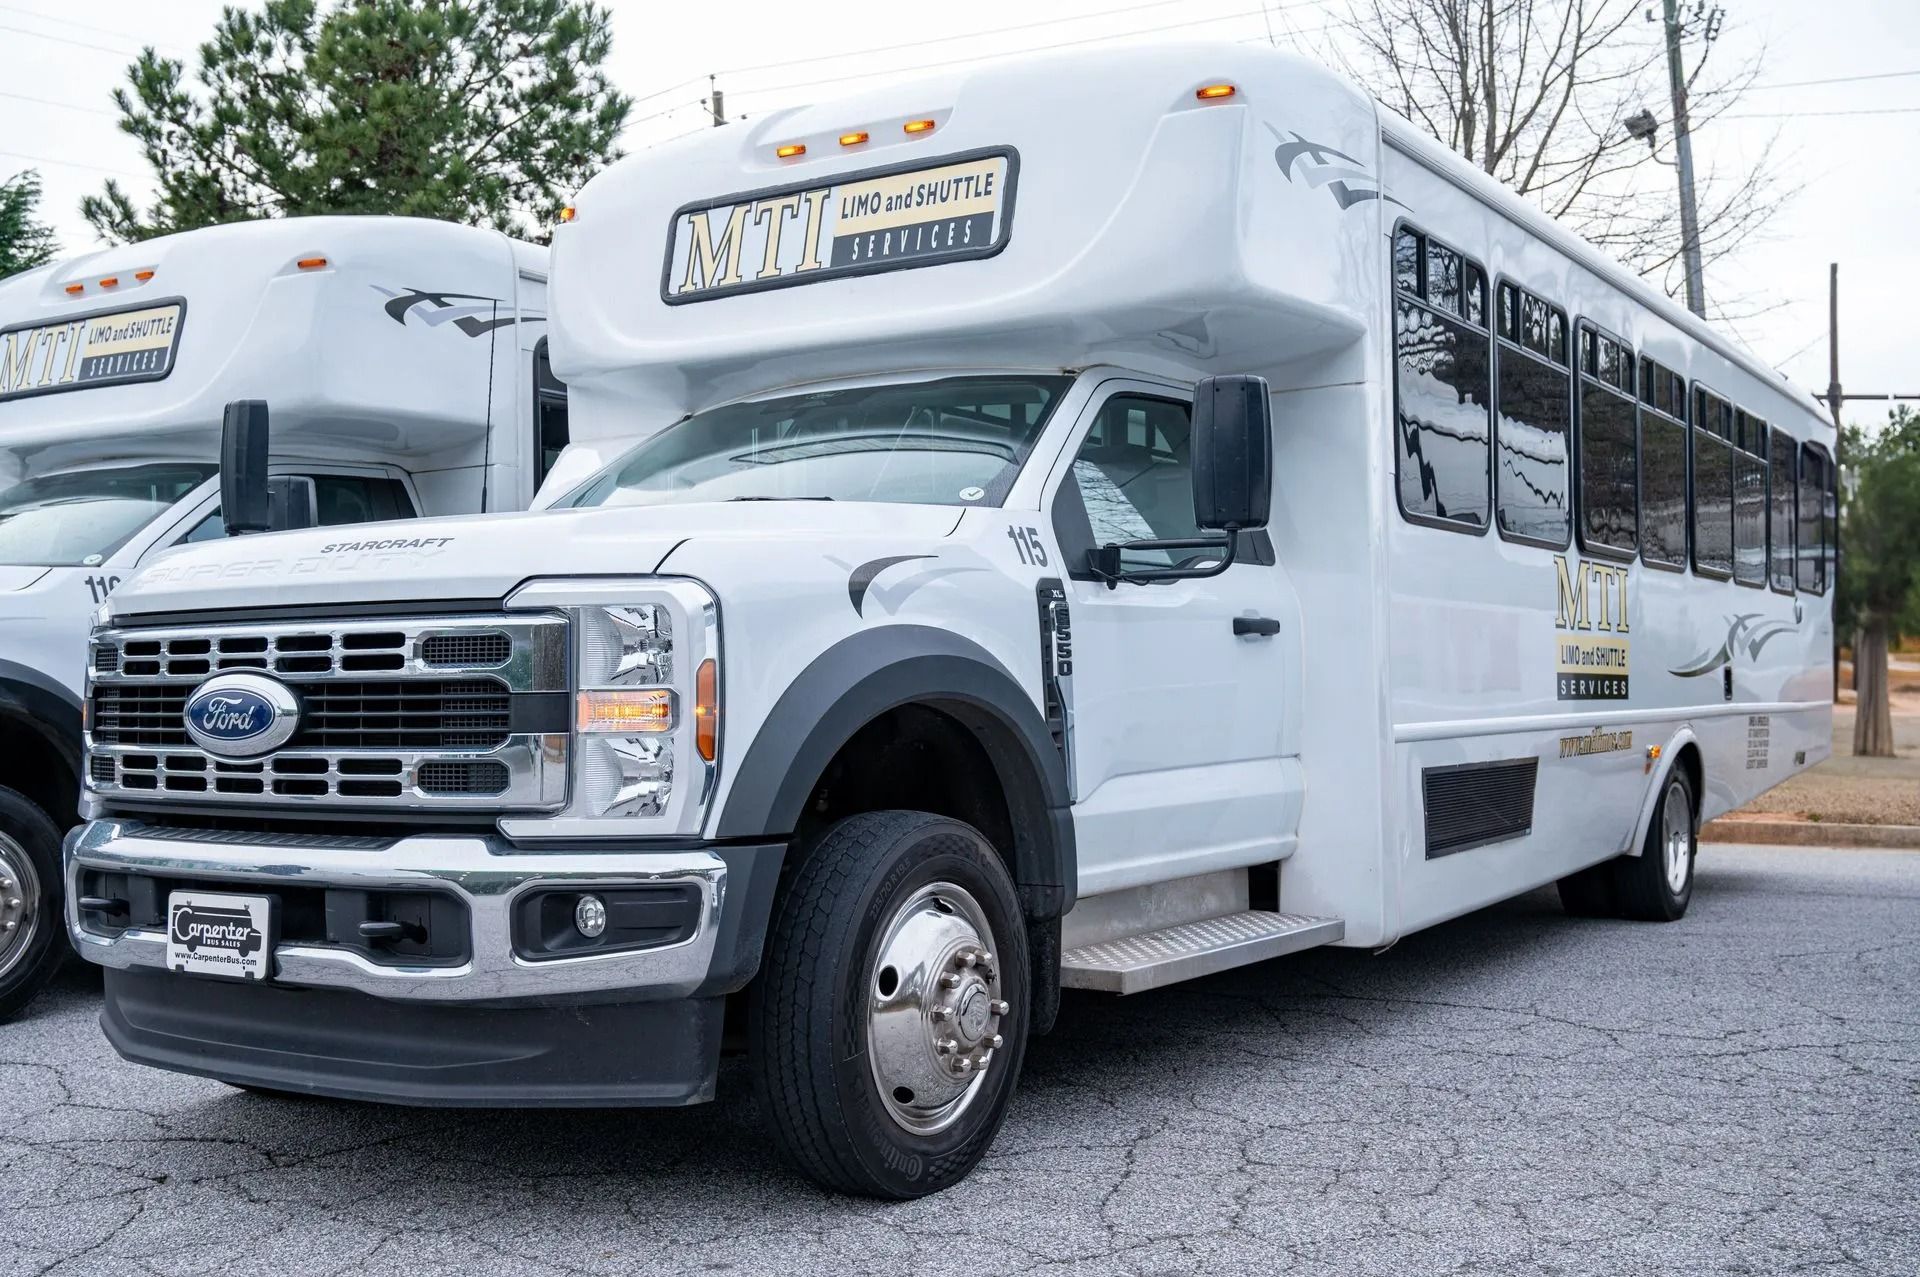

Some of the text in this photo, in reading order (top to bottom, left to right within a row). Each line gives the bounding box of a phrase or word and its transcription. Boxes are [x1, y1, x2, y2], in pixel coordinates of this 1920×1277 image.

[841, 172, 994, 219] LIMO and SHUTTLE
[678, 187, 831, 294] MTI
[852, 219, 971, 261] SERVICES
[88, 316, 174, 345] LIMO and SHUTTLE
[0, 321, 86, 393] MTI
[90, 351, 158, 376] SERVICES
[320, 536, 454, 554] STARCRAFT
[1007, 525, 1048, 567] 115
[140, 550, 449, 589] SUPER DUTY
[1051, 589, 1064, 599] XL
[1554, 555, 1629, 634] MTI
[1561, 644, 1626, 668] LIMO and SHUTTLE
[1560, 679, 1627, 696] SERVICES
[203, 697, 255, 731] Ford
[175, 907, 251, 945] Carpenter
[206, 938, 241, 948] BUS SALES
[174, 951, 257, 966] www.CarpenterBus.com
